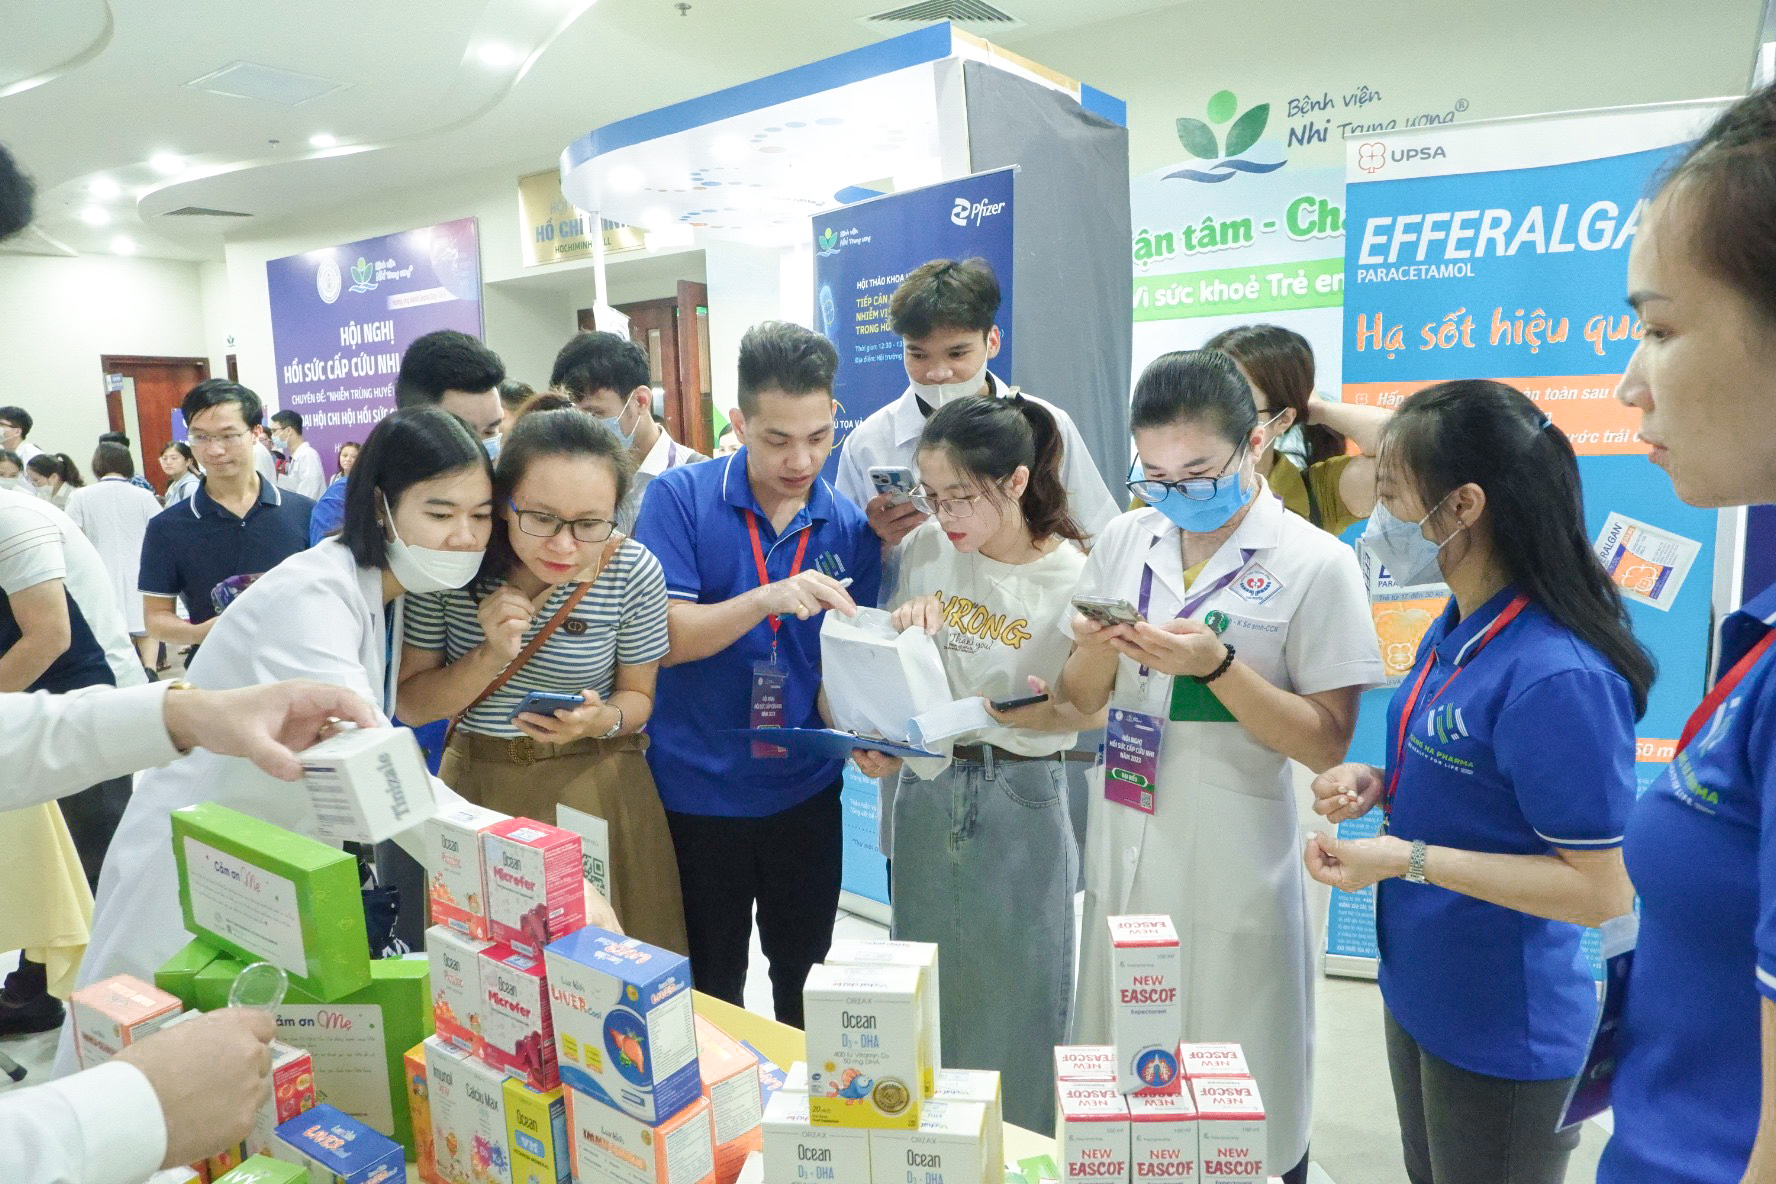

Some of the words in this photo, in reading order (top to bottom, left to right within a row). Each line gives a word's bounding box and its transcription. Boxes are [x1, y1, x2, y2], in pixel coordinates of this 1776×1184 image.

[1287, 92, 1334, 117] Bệnh
[1343, 86, 1382, 108] viện
[1287, 119, 1329, 148] Nhi
[1391, 146, 1446, 162] UPSA
[971, 198, 1005, 226] Pfizer
[536, 218, 554, 243] HỒ
[559, 215, 583, 238] CHÍ
[1358, 199, 1646, 265] EFFERALGA
[1133, 229, 1175, 267] ận
[1182, 216, 1254, 251] tâm
[1357, 263, 1475, 283] PARACETAMOL
[857, 278, 868, 290] HỘI
[887, 274, 904, 284] KHOA
[1154, 278, 1194, 307] sức
[1266, 268, 1309, 296] Trẻ
[856, 295, 872, 308] TIẾP
[340, 321, 361, 349] HỘI
[364, 320, 394, 345] NGHỊ
[856, 324, 879, 335] TRONG
[1356, 312, 1406, 359] Hạ
[1420, 307, 1475, 350] sốt
[1489, 307, 1568, 354] hiệu
[284, 358, 303, 384] HỒI
[305, 357, 325, 382] SỨC
[327, 352, 349, 379] CẤP
[352, 352, 375, 377] CỨU
[378, 353, 400, 374] NHI
[292, 392, 315, 405] CHUYÊN
[351, 386, 373, 399] TRÙNG
[1545, 386, 1578, 400] toàn
[1581, 388, 1609, 400] sau
[314, 411, 326, 429] HỘI
[328, 411, 340, 425] CHI
[341, 411, 356, 427] HỘI
[357, 405, 372, 422] HỒI
[1603, 429, 1630, 442] trái
[1437, 751, 1474, 768] PHARMA
[214, 861, 230, 878] Cảm
[493, 866, 536, 892] Microfer
[1117, 921, 1168, 929] EASCOF
[1133, 975, 1164, 986] NEW
[488, 990, 531, 1018] Microfer
[551, 983, 588, 1013] LIVER
[1120, 988, 1176, 1004] EASCOF
[276, 1015, 295, 1027] ảm
[299, 1018, 315, 1027] ơn
[317, 1010, 352, 1031] Mẹ
[842, 1011, 876, 1029] Ocean
[860, 1034, 880, 1048] DHA
[1189, 1051, 1238, 1059] EASCOF
[1066, 1090, 1117, 1099] EASCOF
[1201, 1087, 1253, 1096] EASCOF
[798, 1144, 831, 1162] Ocean
[907, 1149, 941, 1168] Ocean
[1081, 1149, 1112, 1159] NEW
[1150, 1150, 1181, 1159] NEW
[1217, 1148, 1249, 1158] NEW
[816, 1165, 834, 1179] DHA
[1069, 1161, 1125, 1176] EASCOF
[1137, 1161, 1194, 1176] EASCOF
[1204, 1160, 1262, 1175] EASCOF
[926, 1172, 944, 1184] DHA
